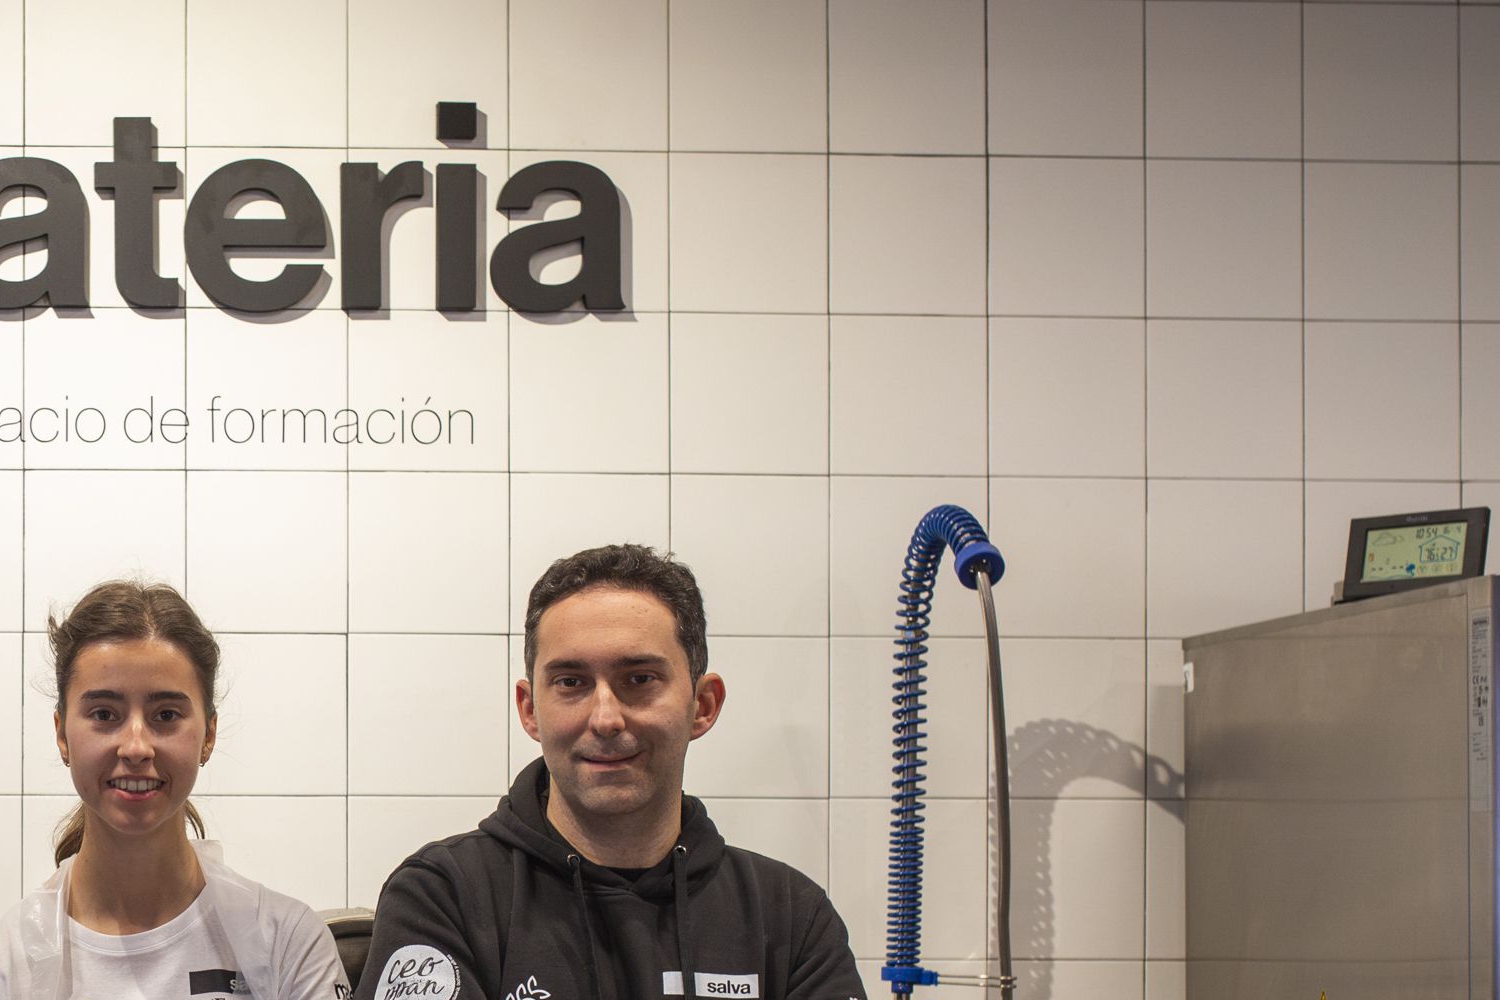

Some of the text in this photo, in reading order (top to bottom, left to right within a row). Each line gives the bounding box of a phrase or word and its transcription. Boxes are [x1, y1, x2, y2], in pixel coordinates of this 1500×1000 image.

[123, 395, 190, 444] de
[207, 395, 474, 445] formación
[387, 956, 445, 985] ceo
[706, 980, 751, 994] salva
